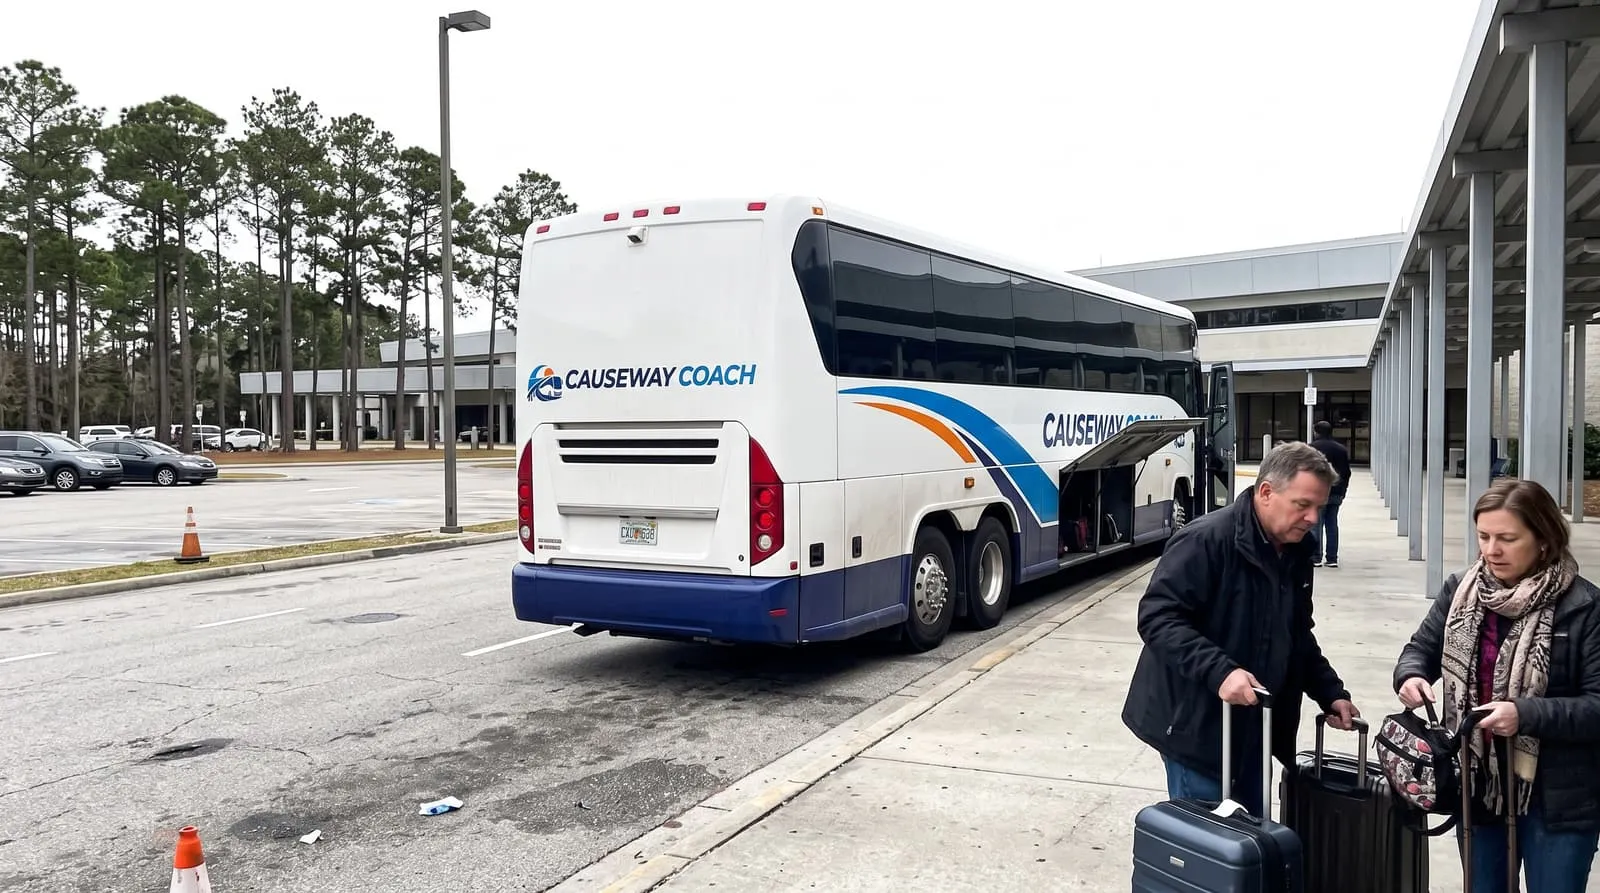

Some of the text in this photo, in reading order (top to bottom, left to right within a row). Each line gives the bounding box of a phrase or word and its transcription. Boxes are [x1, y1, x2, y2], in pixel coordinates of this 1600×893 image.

[566, 364, 757, 390] CAUSEWAY COACH
[1042, 412, 1124, 448] CAUSEWAY
